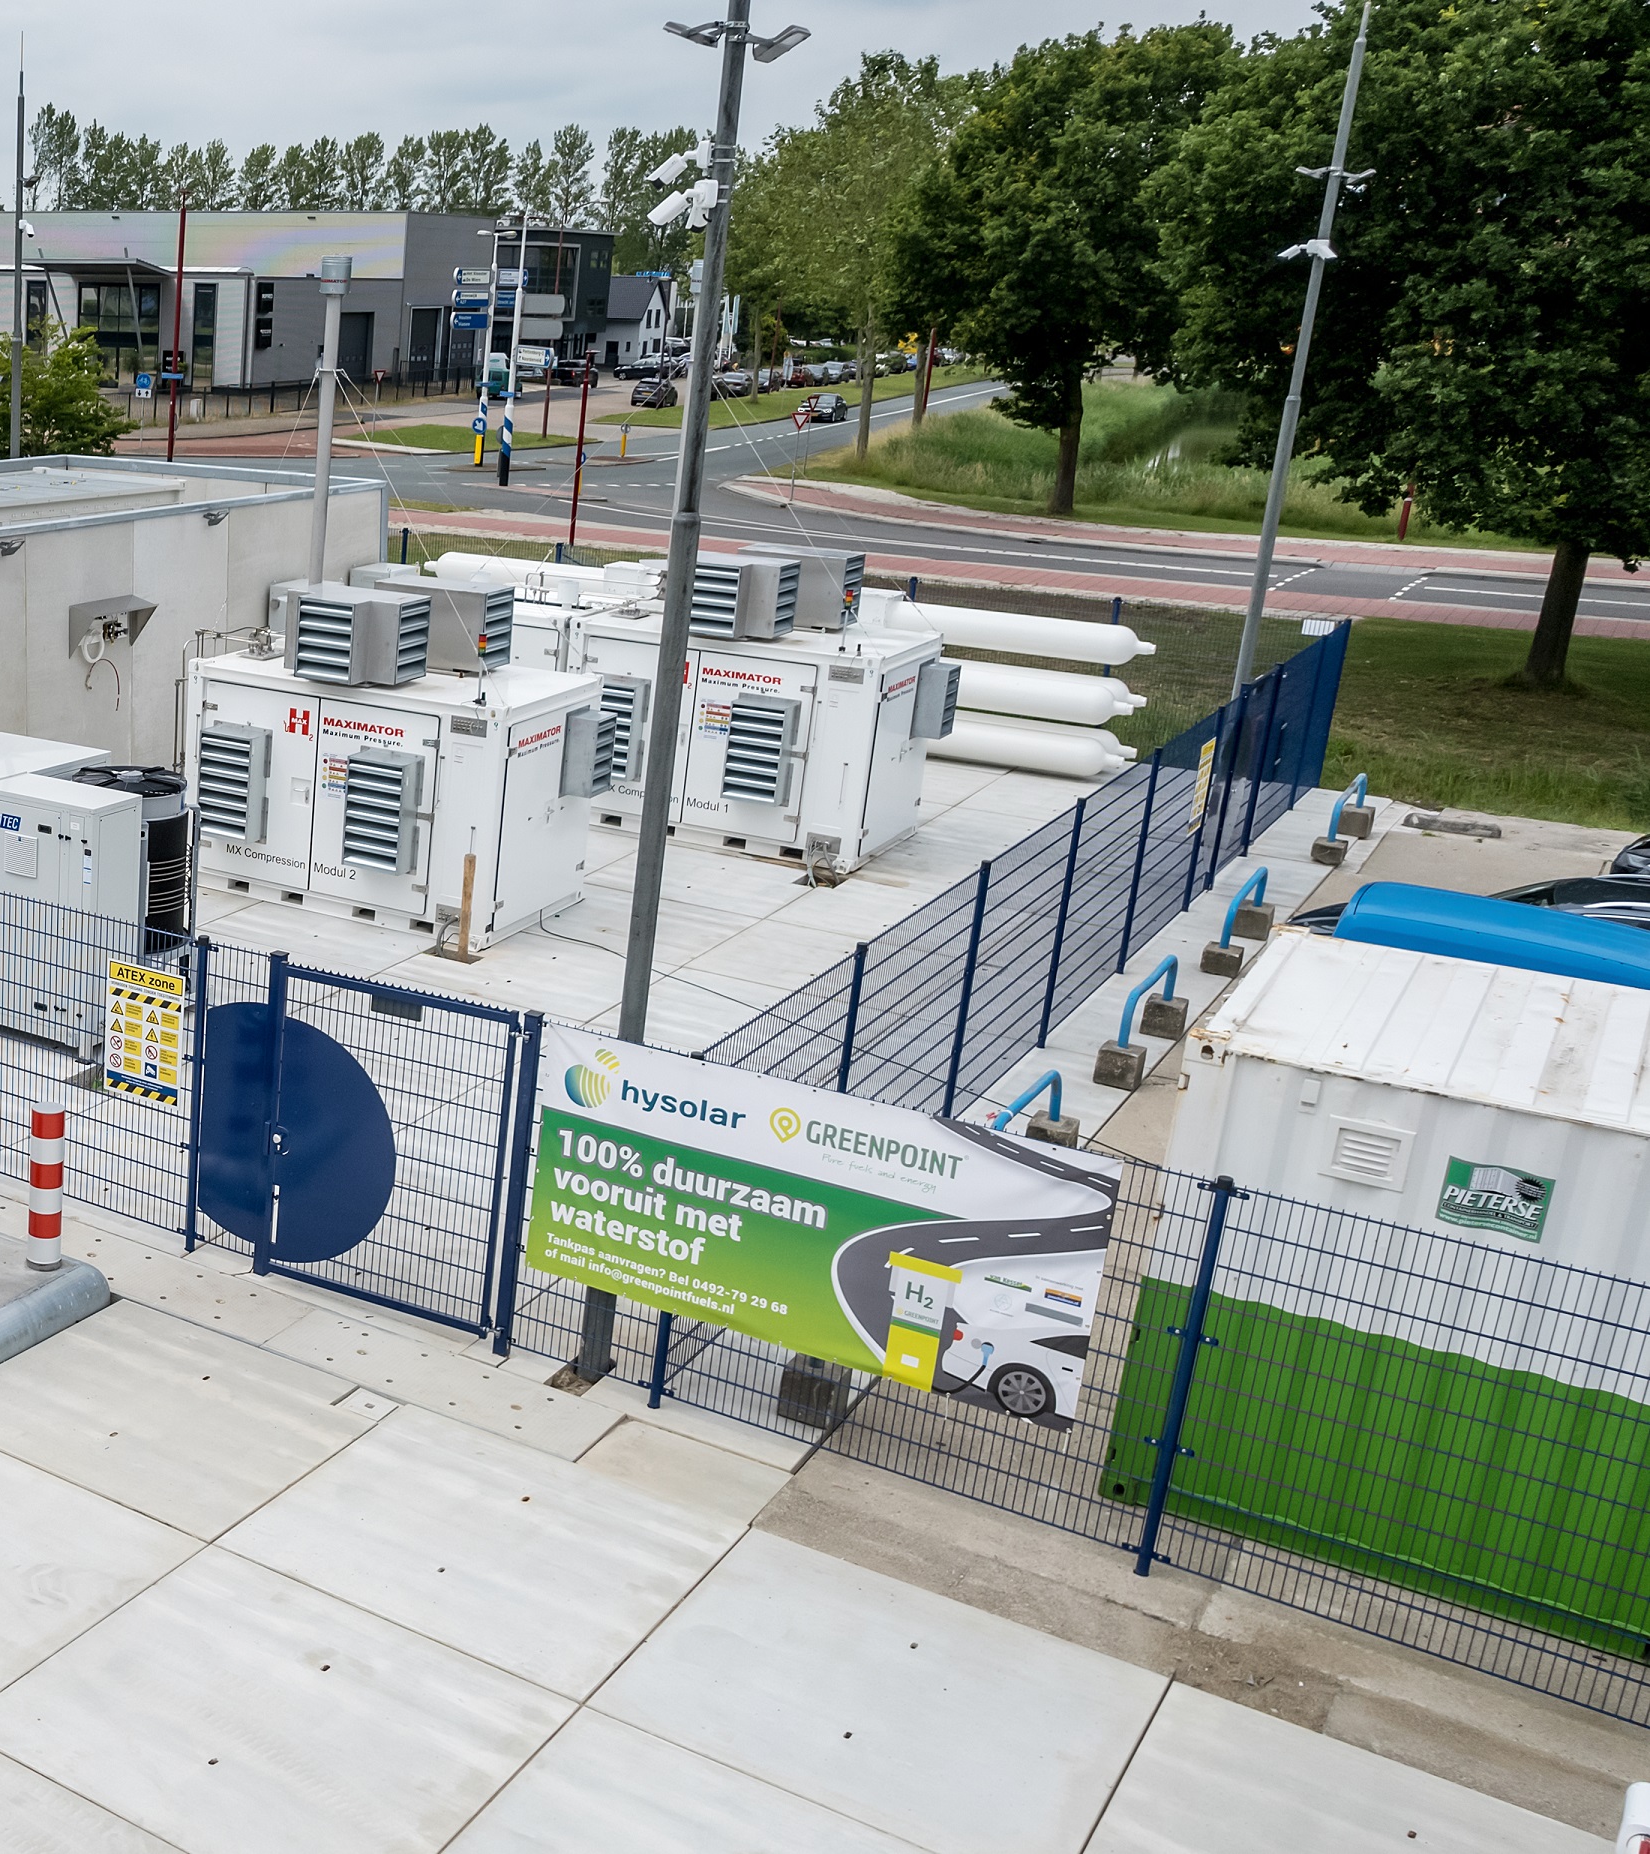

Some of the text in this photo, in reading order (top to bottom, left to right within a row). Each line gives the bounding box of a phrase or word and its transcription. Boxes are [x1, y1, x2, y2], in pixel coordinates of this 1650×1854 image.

[701, 677, 780, 694] Maximum Pressure.
[702, 667, 782, 685] MAXIMATOR
[322, 728, 403, 747] Maximum Pressure.
[323, 717, 405, 737] MAXIMATOR
[518, 725, 562, 749] MAXIMATOR
[686, 797, 720, 812] Modul
[724, 804, 729, 813] 1
[226, 844, 357, 880] MX Compression Modul 2
[117, 967, 175, 991] ATEX zone
[621, 1079, 746, 1129] hysolar
[806, 1120, 963, 1180] GREENPOINT
[558, 1129, 827, 1230] 100% duurzaam
[822, 1153, 937, 1194] Pure fuels and energy
[553, 1167, 743, 1242] vooruit met
[1443, 1184, 1544, 1220] PIETERSE
[550, 1200, 706, 1266] waterstof
[544, 1248, 735, 1315] of mail info@greenpointfuels.nl
[547, 1232, 788, 1315] Tankpas aanvragen? Bel 0492-79 29 68
